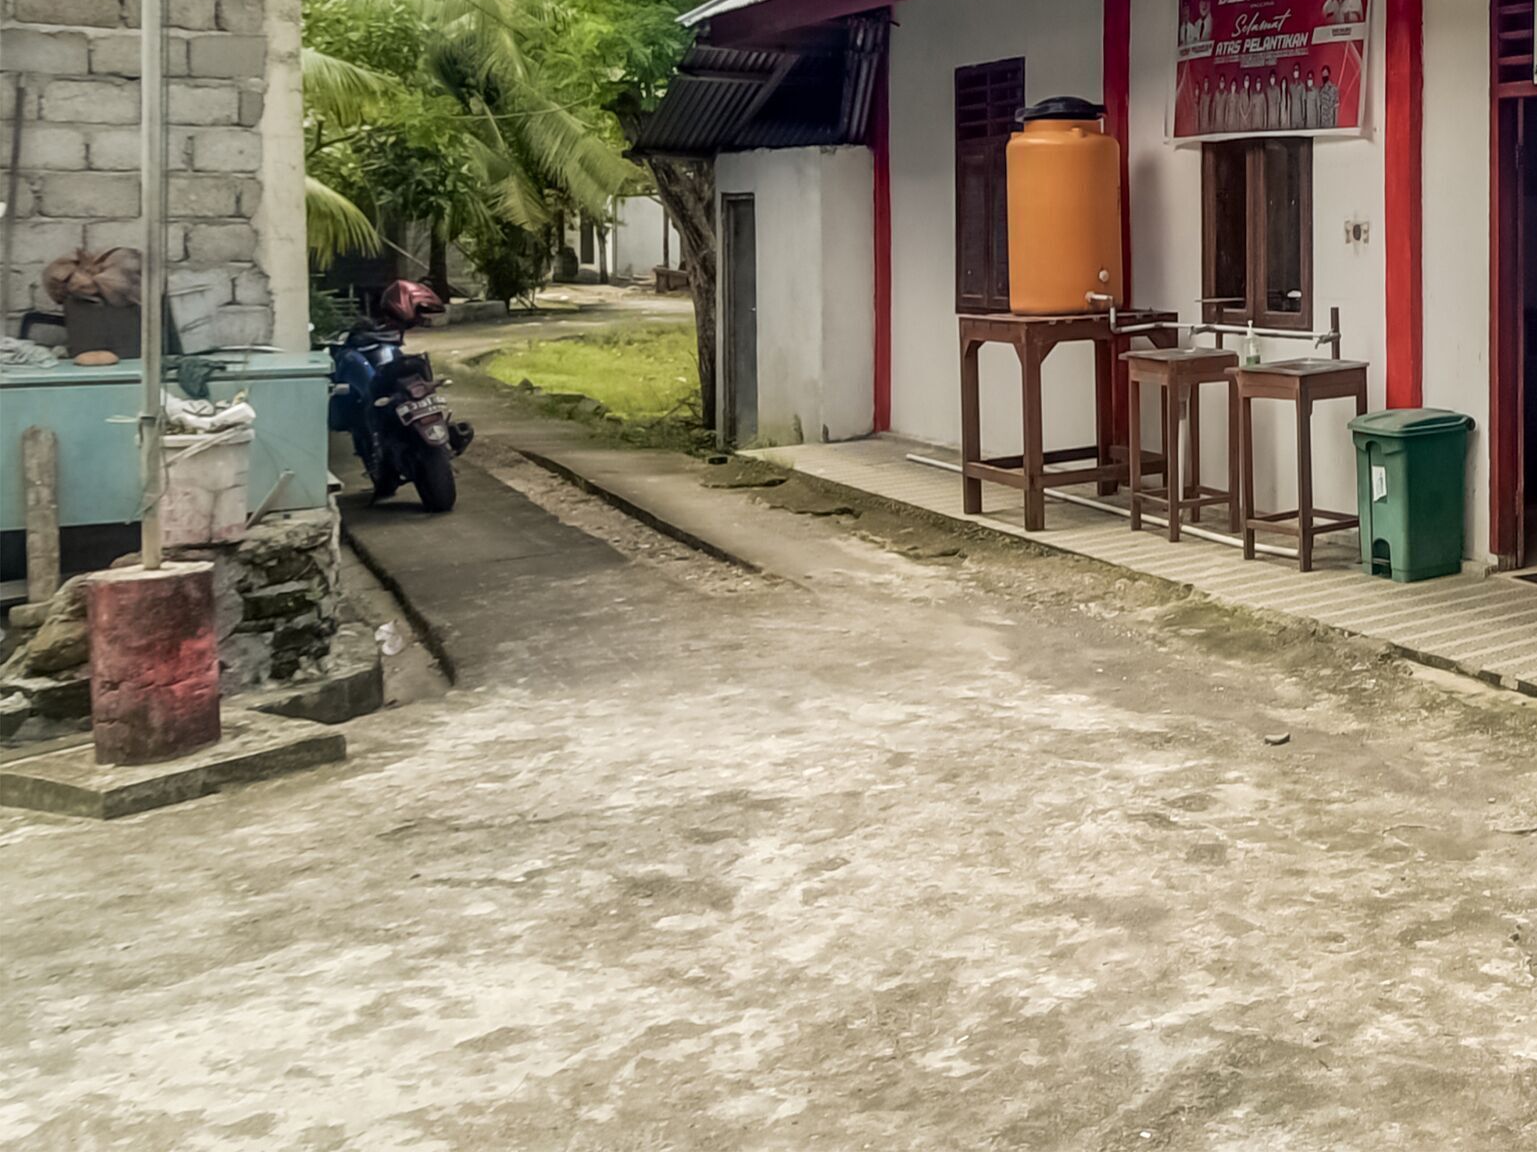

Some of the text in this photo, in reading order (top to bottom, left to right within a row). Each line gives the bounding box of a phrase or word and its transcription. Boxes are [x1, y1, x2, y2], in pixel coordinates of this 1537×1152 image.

[1231, 9, 1291, 37] Selamat
[1216, 40, 1242, 56] ATAS
[1243, 32, 1309, 53] PELANTIKAN
